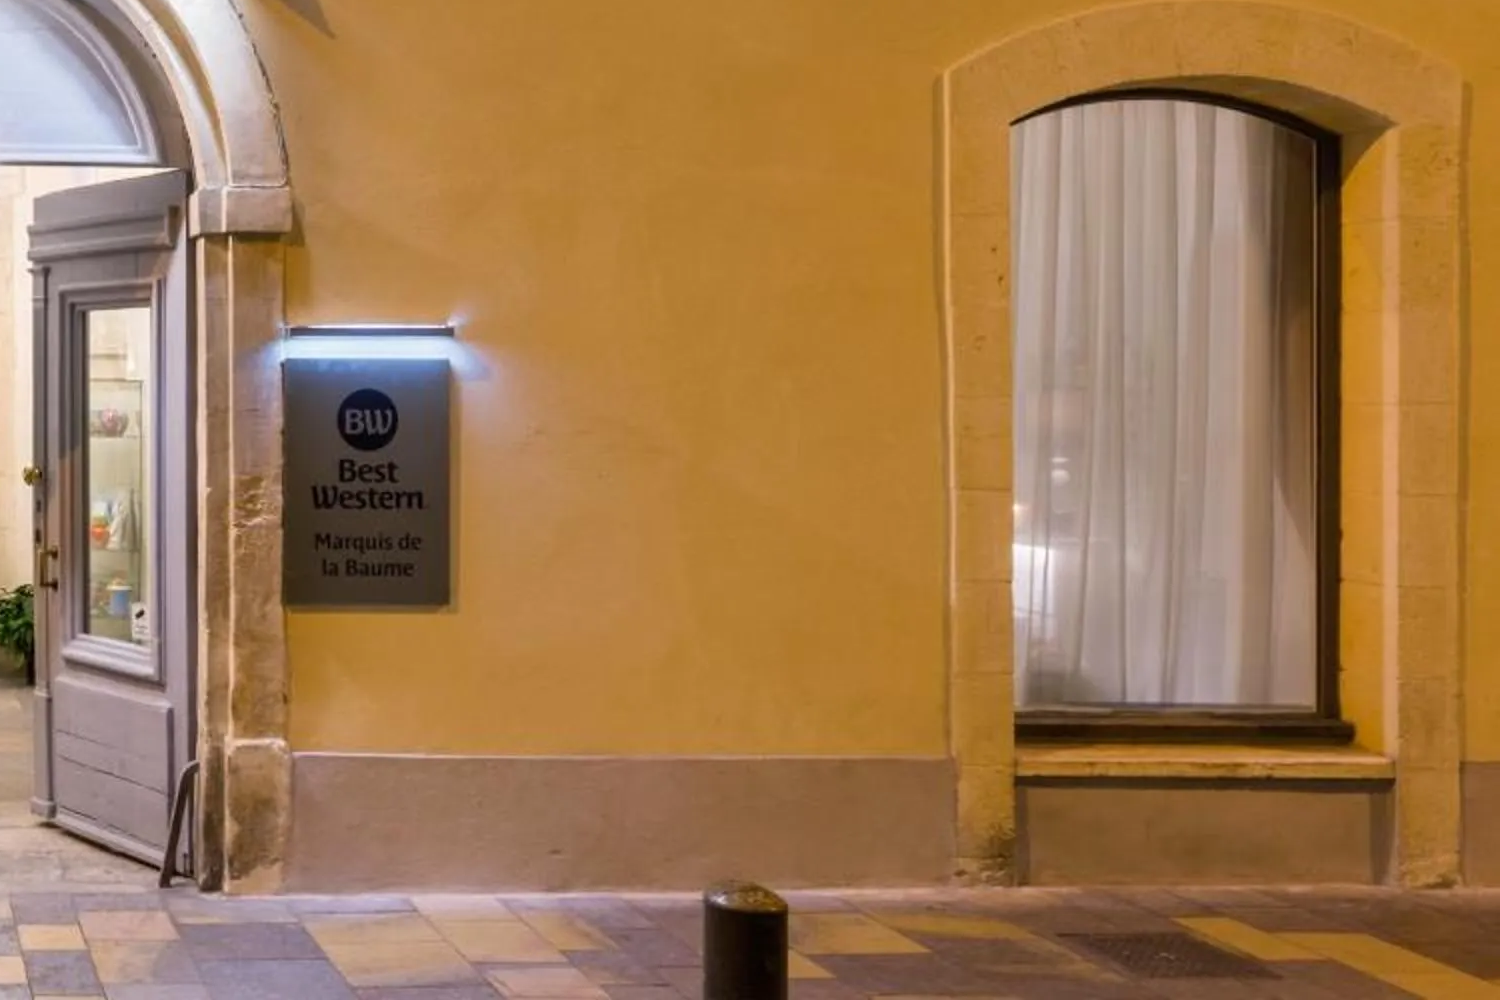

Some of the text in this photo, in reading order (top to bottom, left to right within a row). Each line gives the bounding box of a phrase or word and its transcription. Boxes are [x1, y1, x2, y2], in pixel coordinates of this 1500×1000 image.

[344, 408, 393, 435] BW
[338, 459, 399, 483] Best
[311, 486, 424, 510] Western
[314, 533, 422, 555] Marquis de
[320, 559, 415, 577] la Baume
